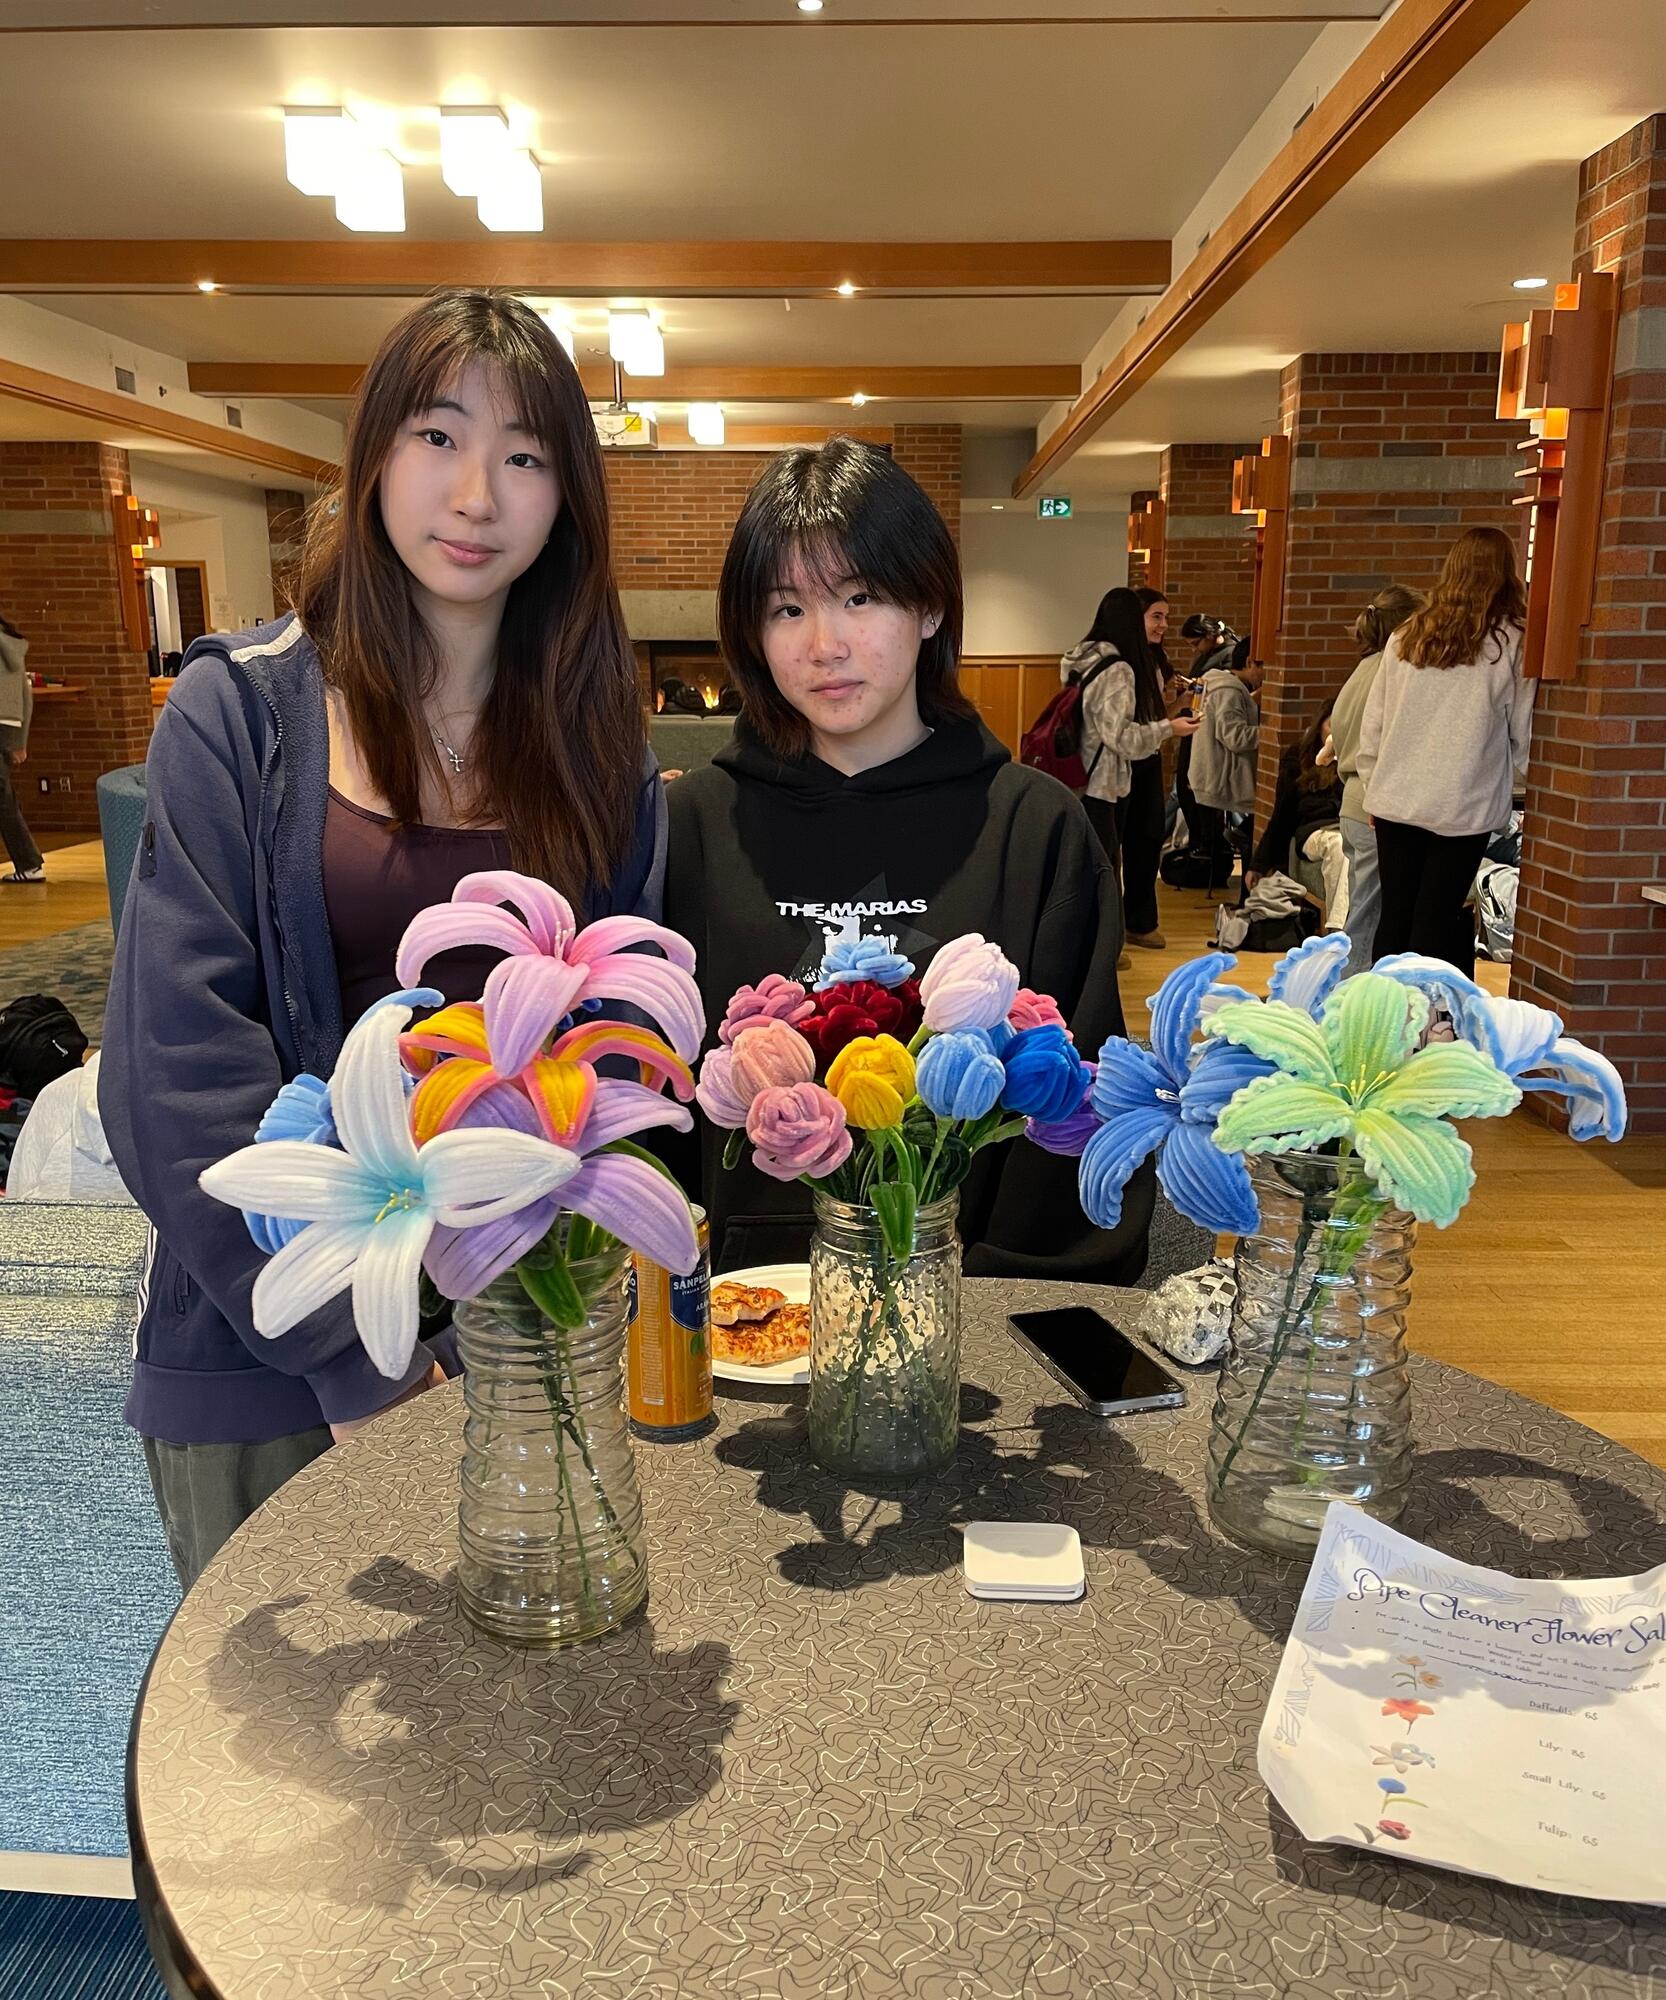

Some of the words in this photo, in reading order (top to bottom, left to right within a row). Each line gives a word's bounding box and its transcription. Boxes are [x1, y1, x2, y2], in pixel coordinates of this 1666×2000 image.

[775, 901, 825, 917] THE
[830, 899, 928, 916] MARIAS
[1347, 1567, 1411, 1604] Pipe
[1419, 1592, 1532, 1633] Cleaner
[1528, 1617, 1623, 1648] Flower
[1624, 1612, 1666, 1654] Sal
[1521, 1771, 1552, 1784] Small
